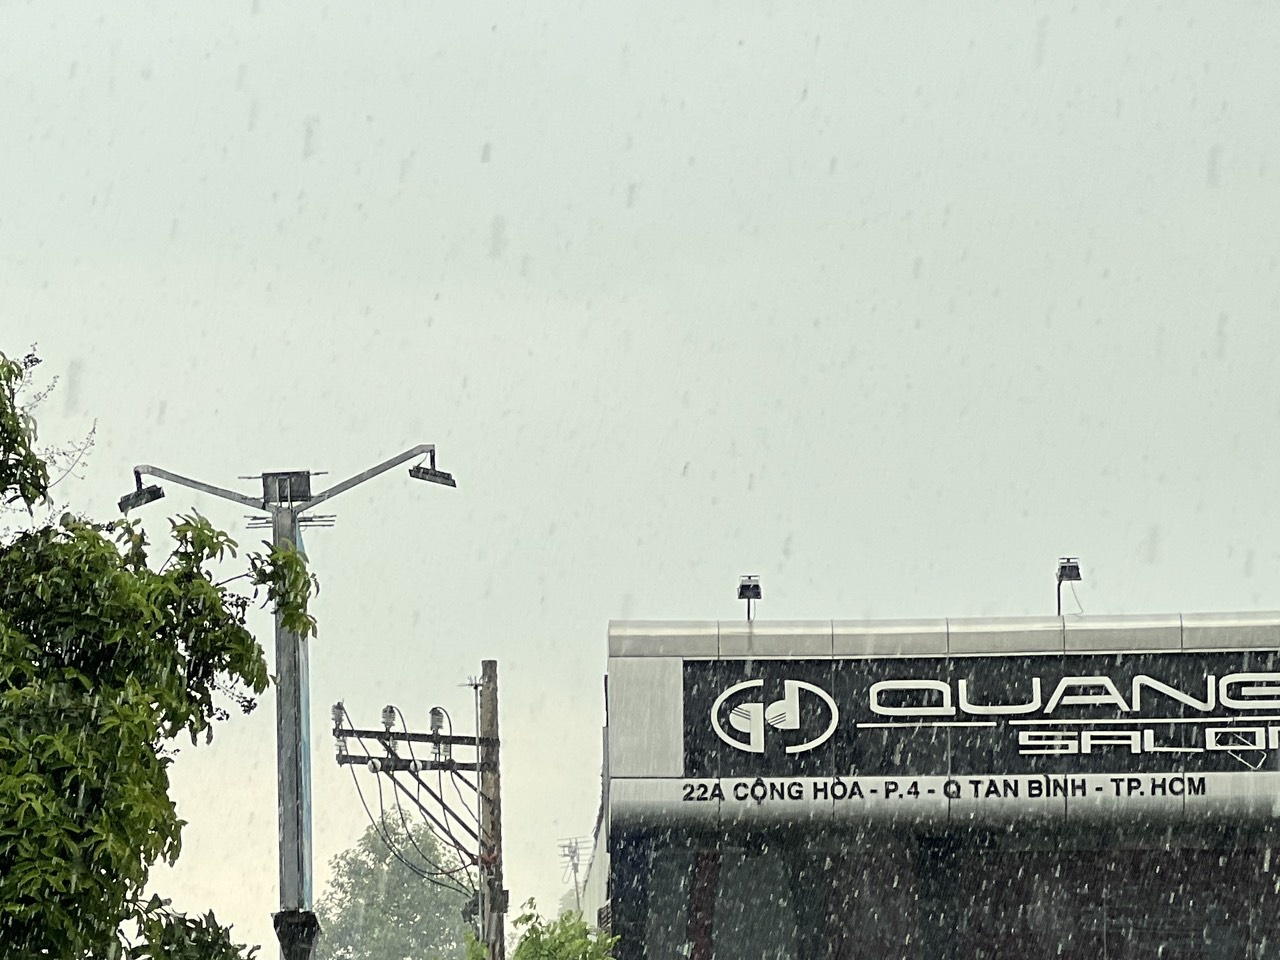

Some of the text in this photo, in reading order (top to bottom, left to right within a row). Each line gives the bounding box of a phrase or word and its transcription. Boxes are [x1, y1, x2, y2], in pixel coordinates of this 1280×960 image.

[870, 674, 1280, 716] QUANG
[682, 783, 725, 801] 22A
[733, 778, 804, 805] CỘNG
[813, 777, 864, 800] HÒA
[884, 781, 920, 799] P.4
[1028, 774, 1087, 798] BÌNH
[1110, 778, 1144, 796] TP.
[1151, 777, 1206, 796] HCM
